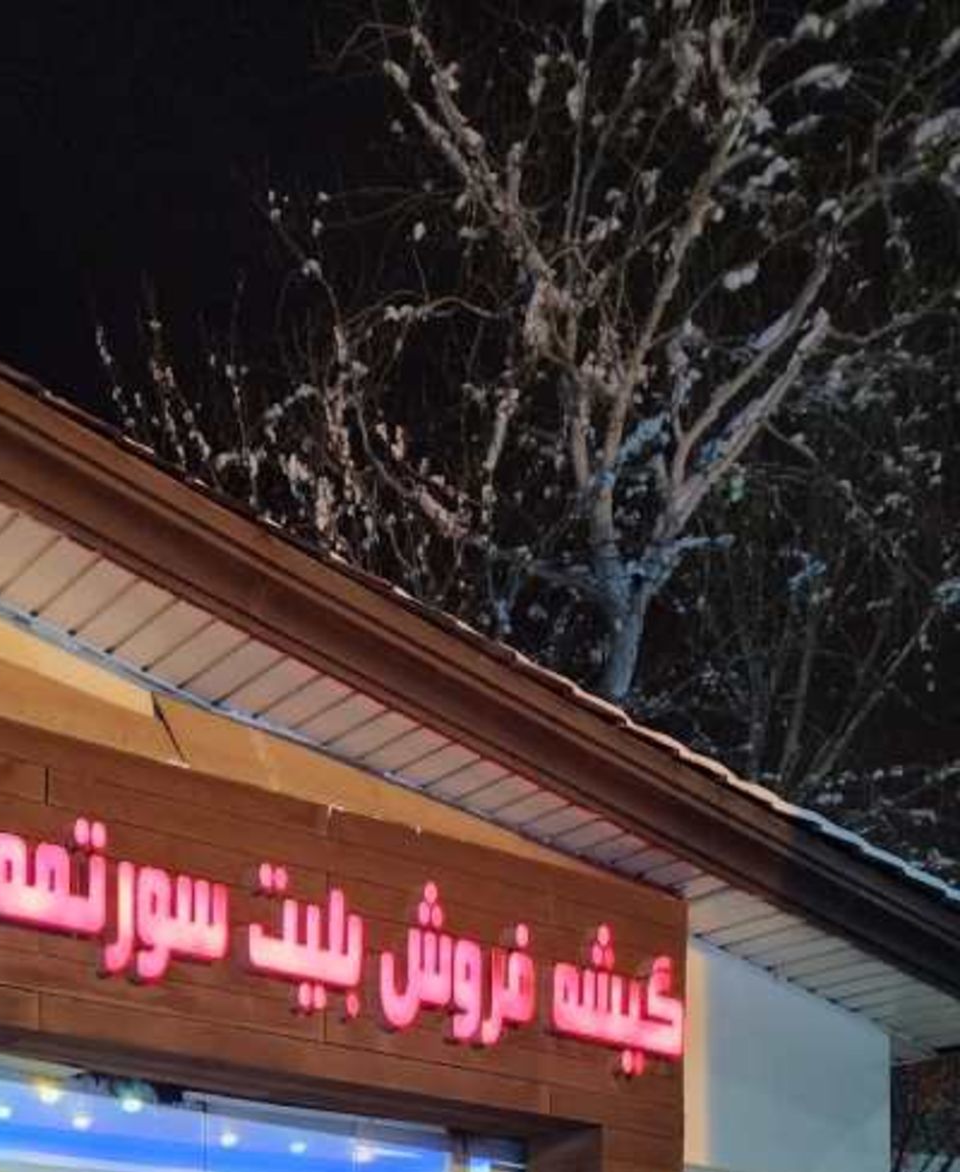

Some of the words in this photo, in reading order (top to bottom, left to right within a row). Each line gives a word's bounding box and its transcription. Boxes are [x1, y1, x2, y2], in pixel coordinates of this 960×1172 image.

[247, 862, 365, 1018] بلیت
[380, 881, 536, 1045] فروش
[552, 924, 684, 1075] گیشه
